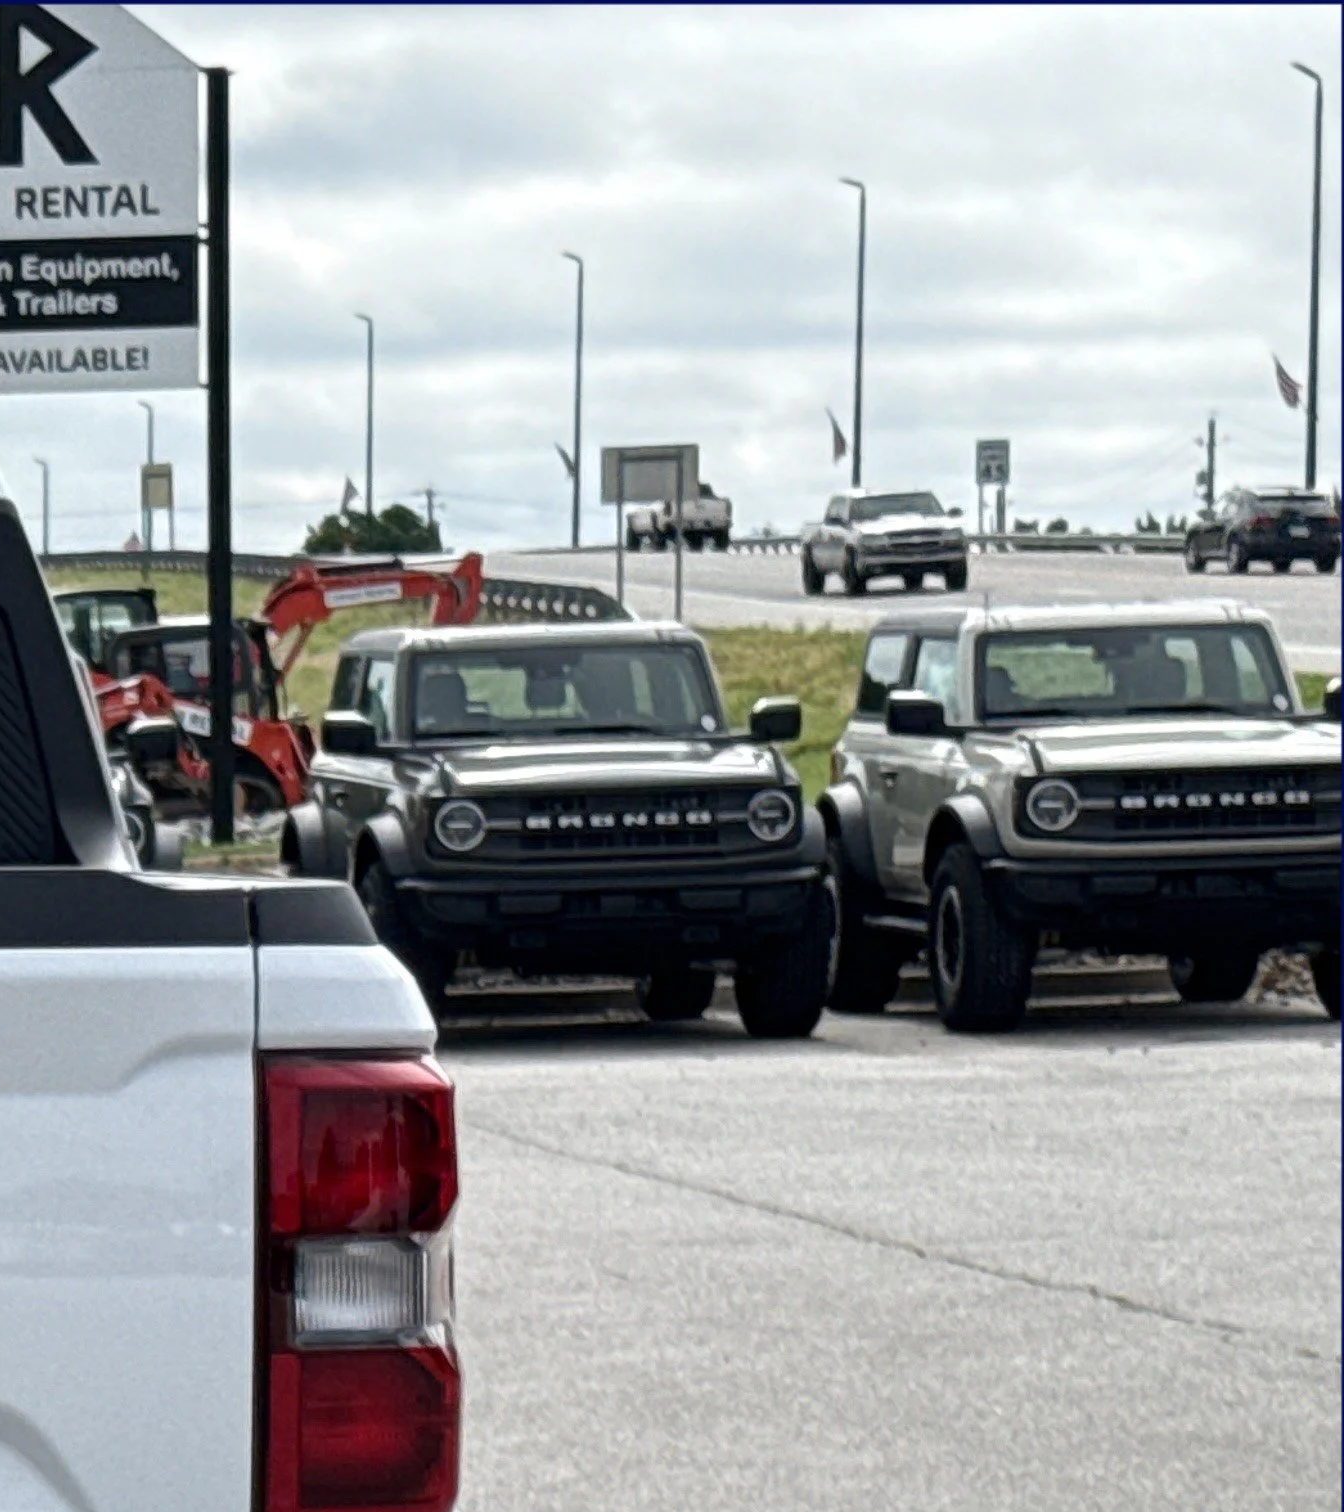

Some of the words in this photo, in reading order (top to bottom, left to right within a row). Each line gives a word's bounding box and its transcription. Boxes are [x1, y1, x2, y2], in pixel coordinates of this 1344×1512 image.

[14, 183, 161, 220] RENTAL
[19, 252, 180, 286] Equipment,
[12, 290, 118, 317] Trailers
[1119, 790, 1311, 809] BRONCO
[525, 810, 713, 830] BRONCO
